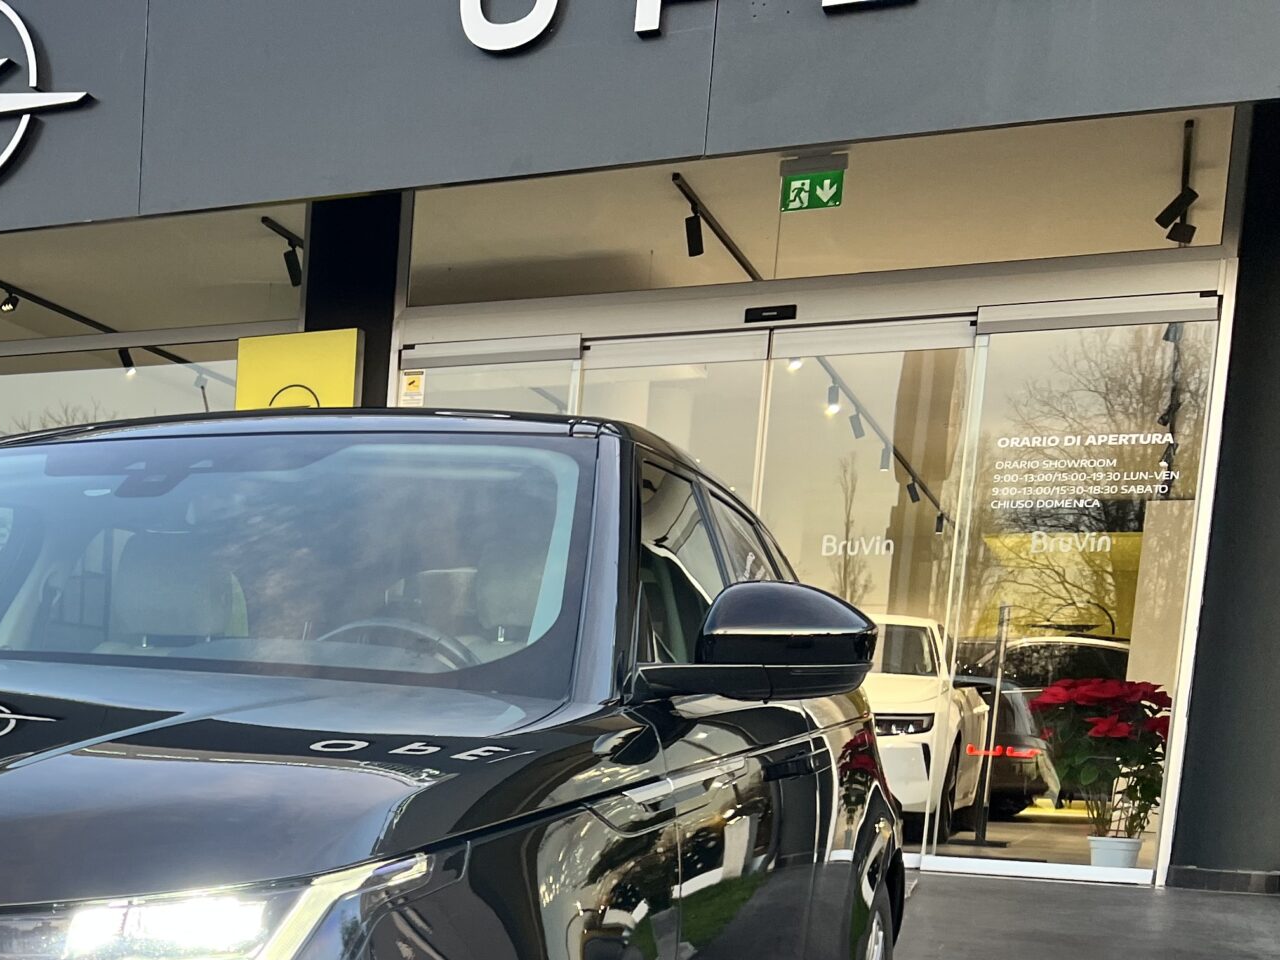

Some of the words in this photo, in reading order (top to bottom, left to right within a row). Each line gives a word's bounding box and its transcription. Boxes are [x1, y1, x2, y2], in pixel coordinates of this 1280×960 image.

[997, 435, 1060, 448] ORARIO
[1063, 435, 1082, 447] DI
[1084, 432, 1174, 446] APERTURA
[995, 460, 1040, 470] ORARIO
[1042, 458, 1117, 469] SHOWROOM
[1123, 470, 1180, 481] LUN-VEN
[1120, 484, 1169, 494] SABATO
[990, 499, 1034, 509] CHIUSO
[1036, 498, 1100, 509] DOMENICA
[821, 534, 894, 556] BruVin
